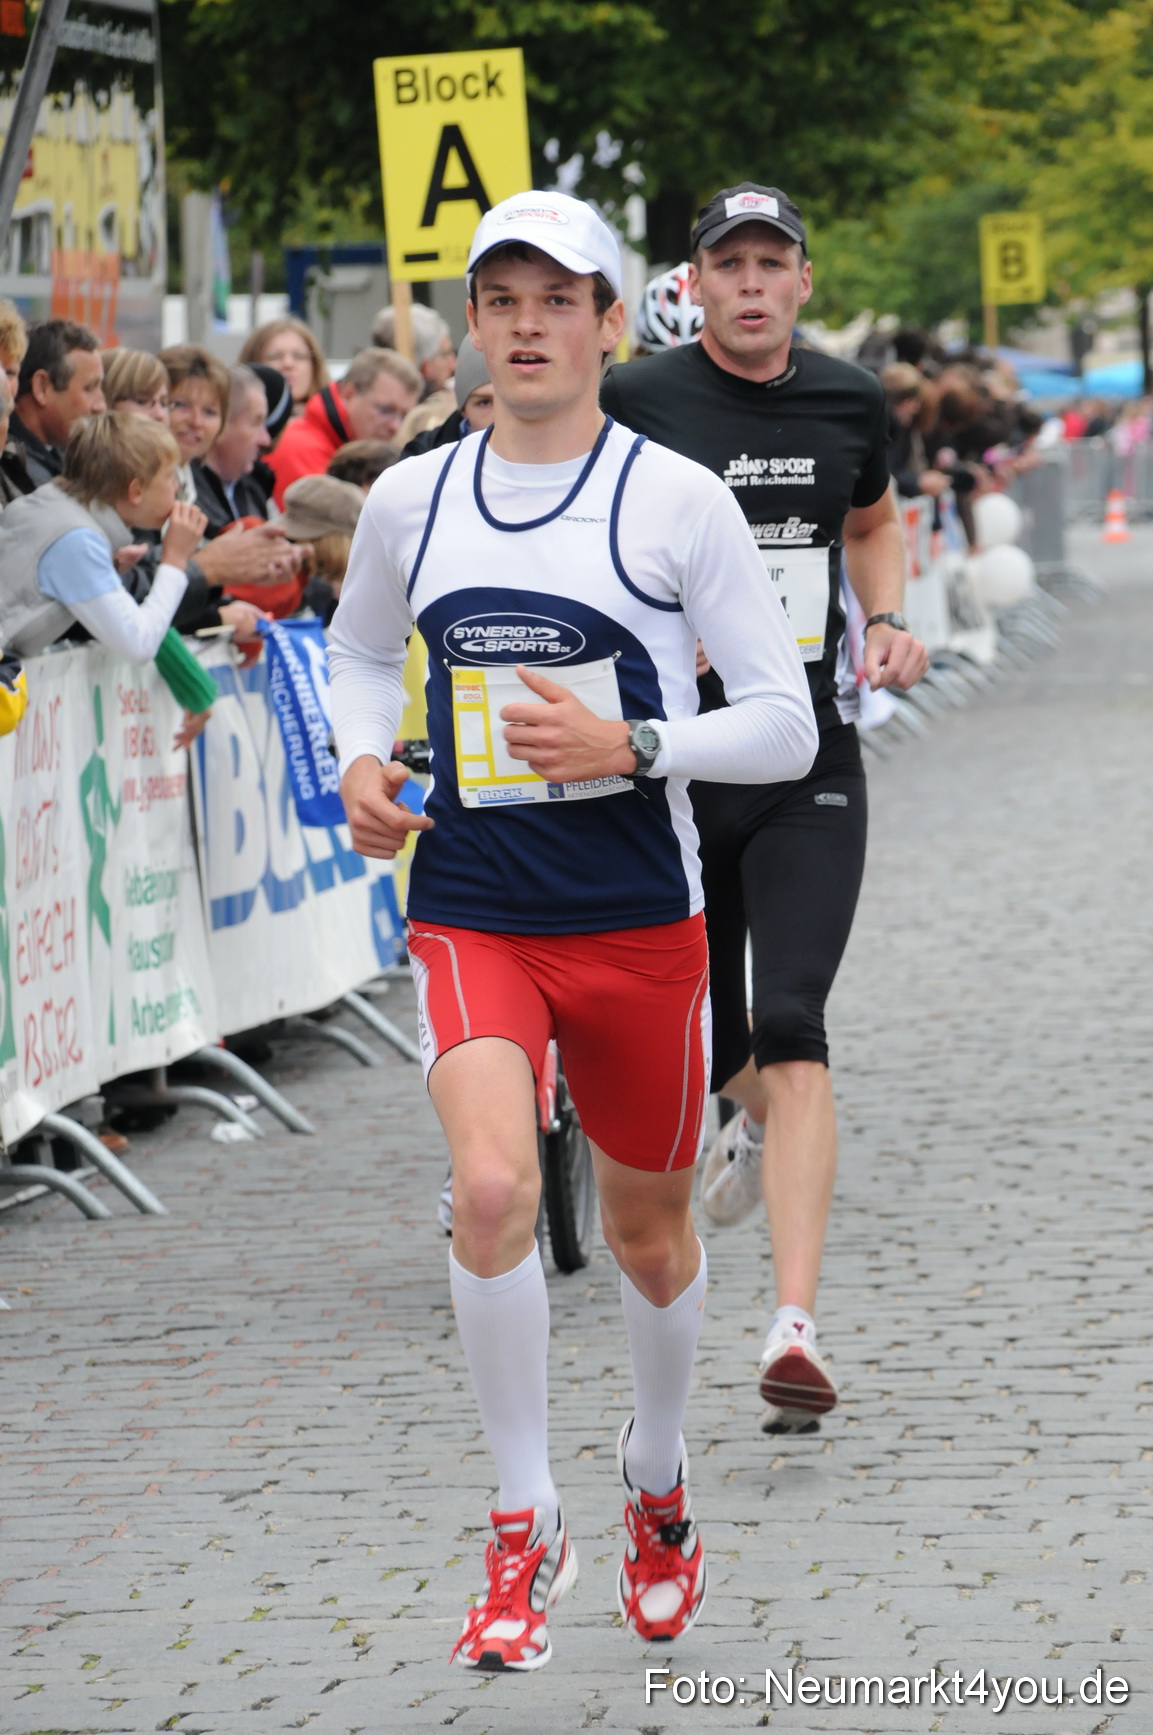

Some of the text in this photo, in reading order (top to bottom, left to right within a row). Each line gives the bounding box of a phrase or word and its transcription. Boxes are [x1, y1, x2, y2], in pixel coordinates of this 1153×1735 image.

[394, 60, 505, 106] Block
[419, 123, 493, 228] A
[999, 240, 1027, 282] B
[769, 457, 816, 475] SPORT
[724, 474, 816, 488] Bad Reichenhall
[453, 625, 543, 640] SYNERGY
[478, 787, 524, 801] BOCK
